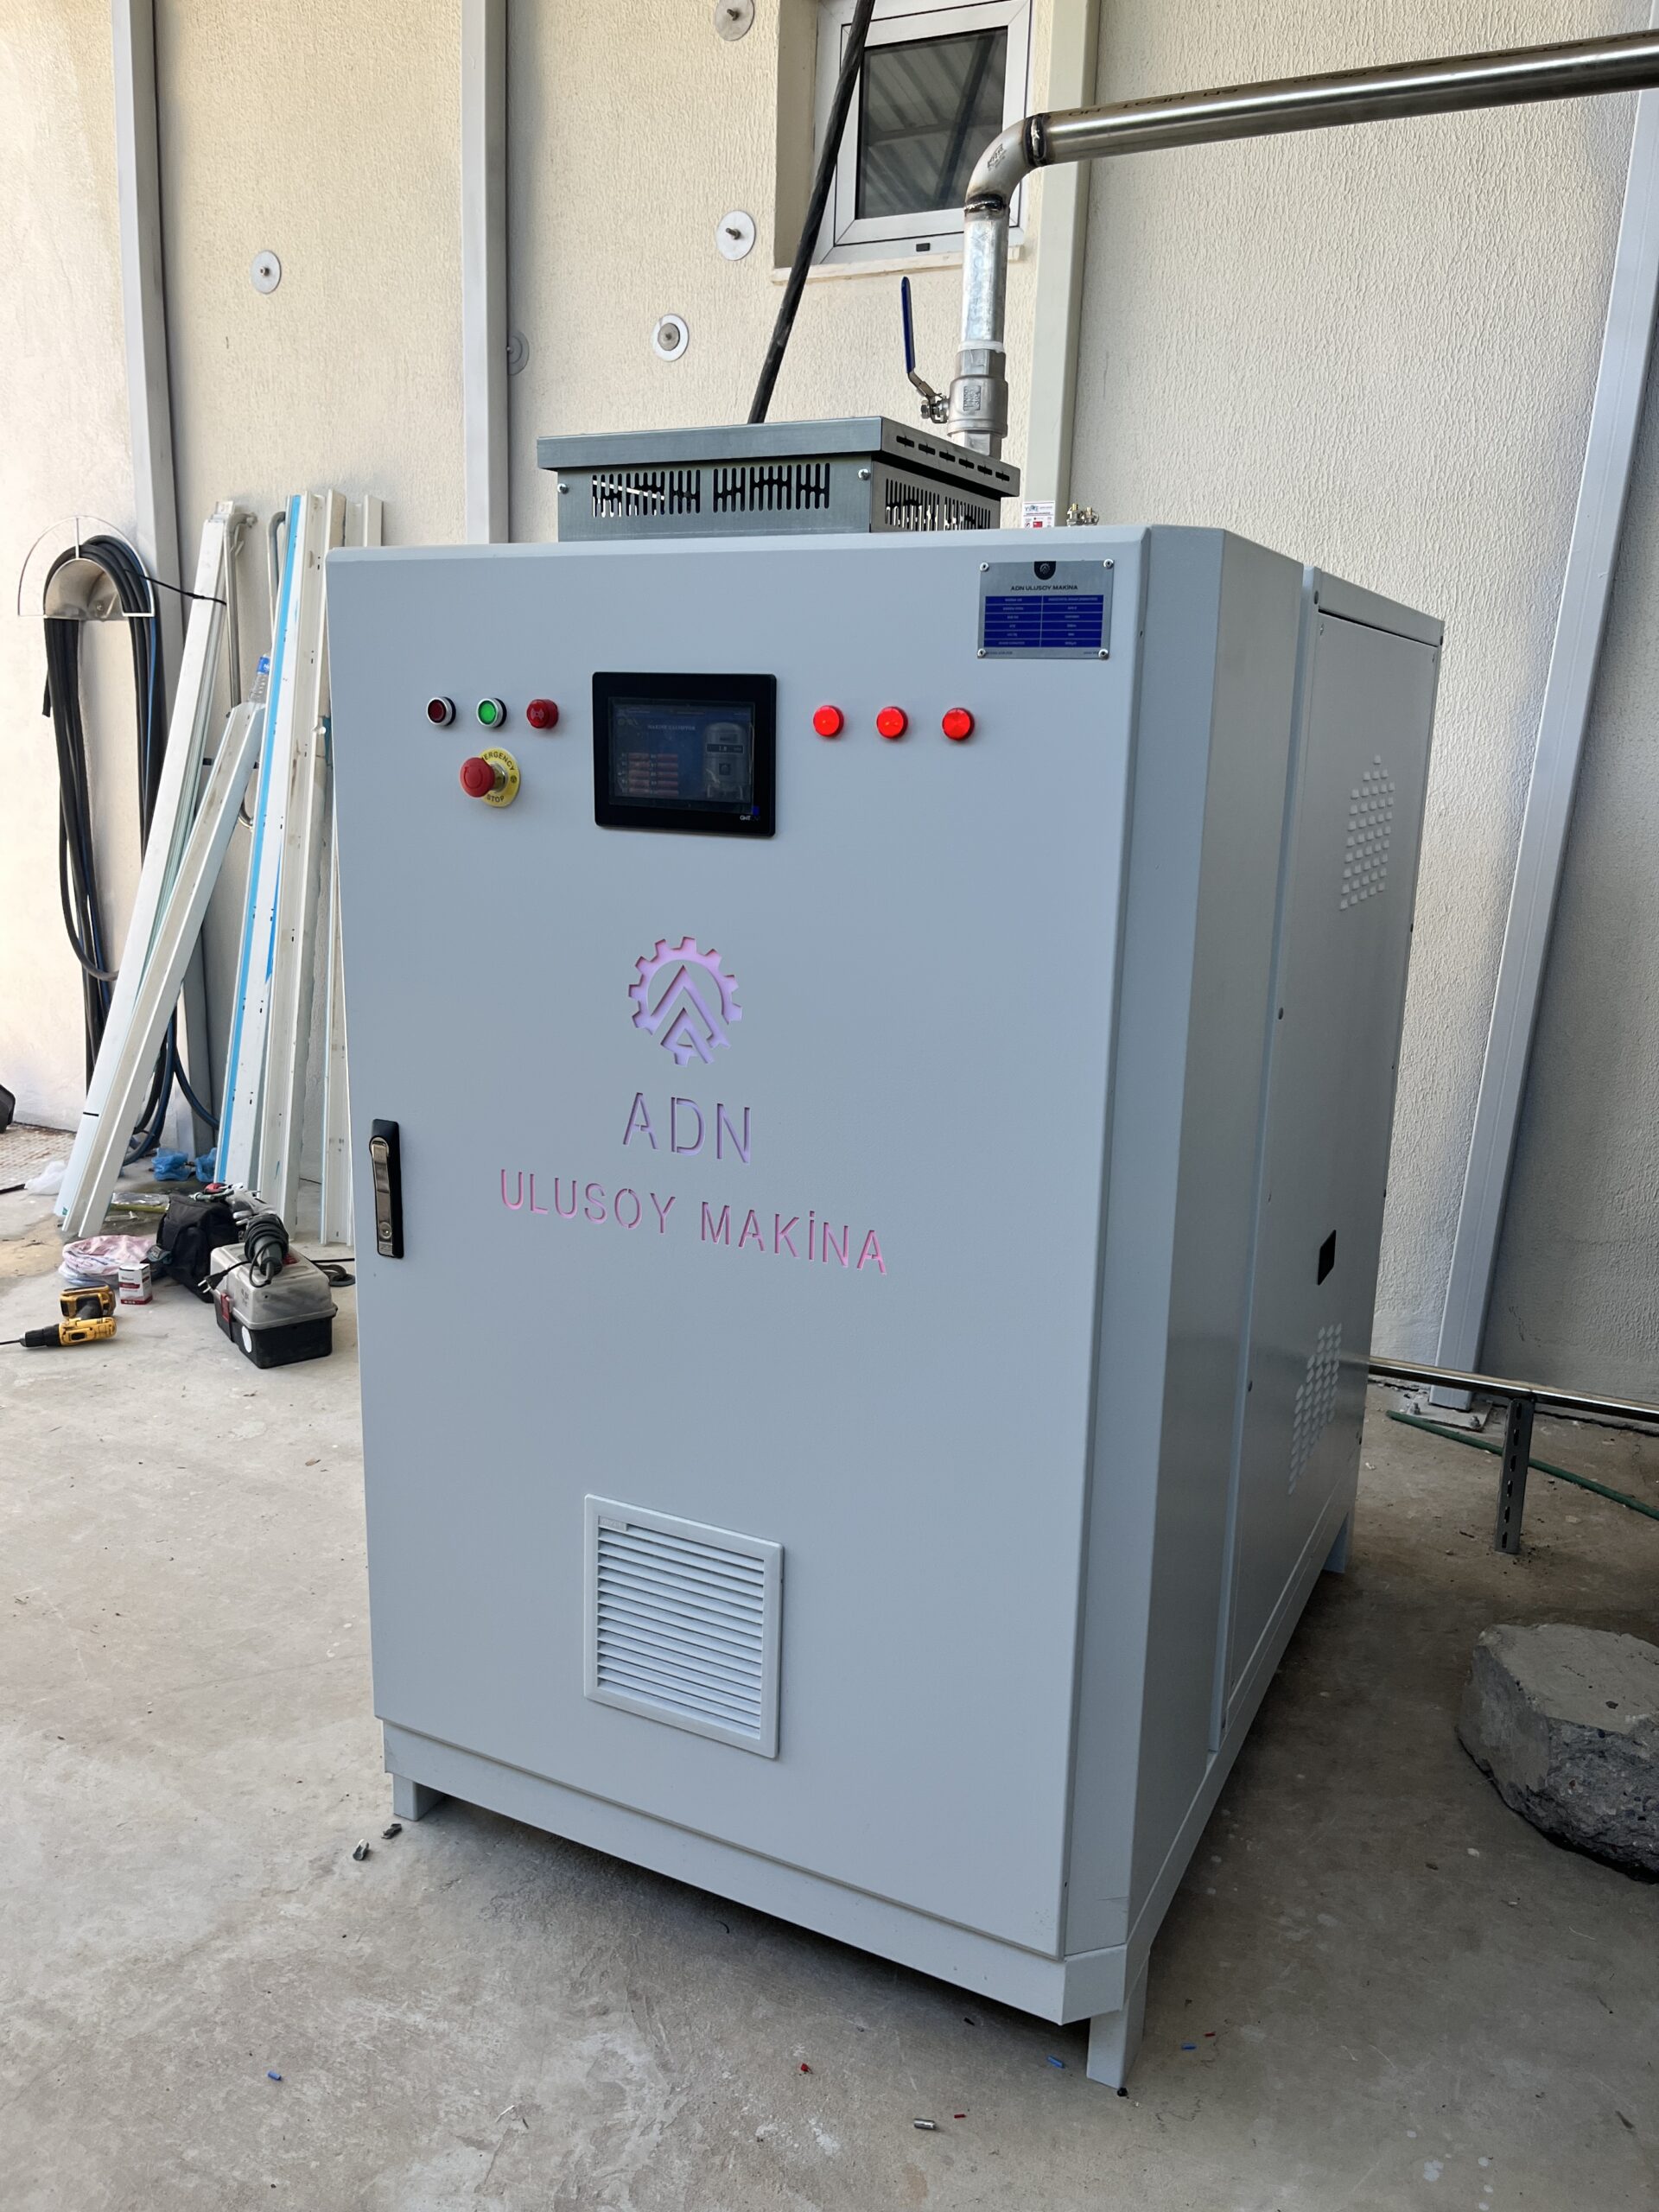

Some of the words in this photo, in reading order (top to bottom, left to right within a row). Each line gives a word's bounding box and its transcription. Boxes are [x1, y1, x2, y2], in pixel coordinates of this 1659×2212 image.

[482, 751, 515, 771] ERGENCY
[486, 793, 505, 803] STOP
[622, 1091, 752, 1166] ADN
[500, 1168, 677, 1235] ULUSOY
[700, 1201, 887, 1275] MAKİNA
